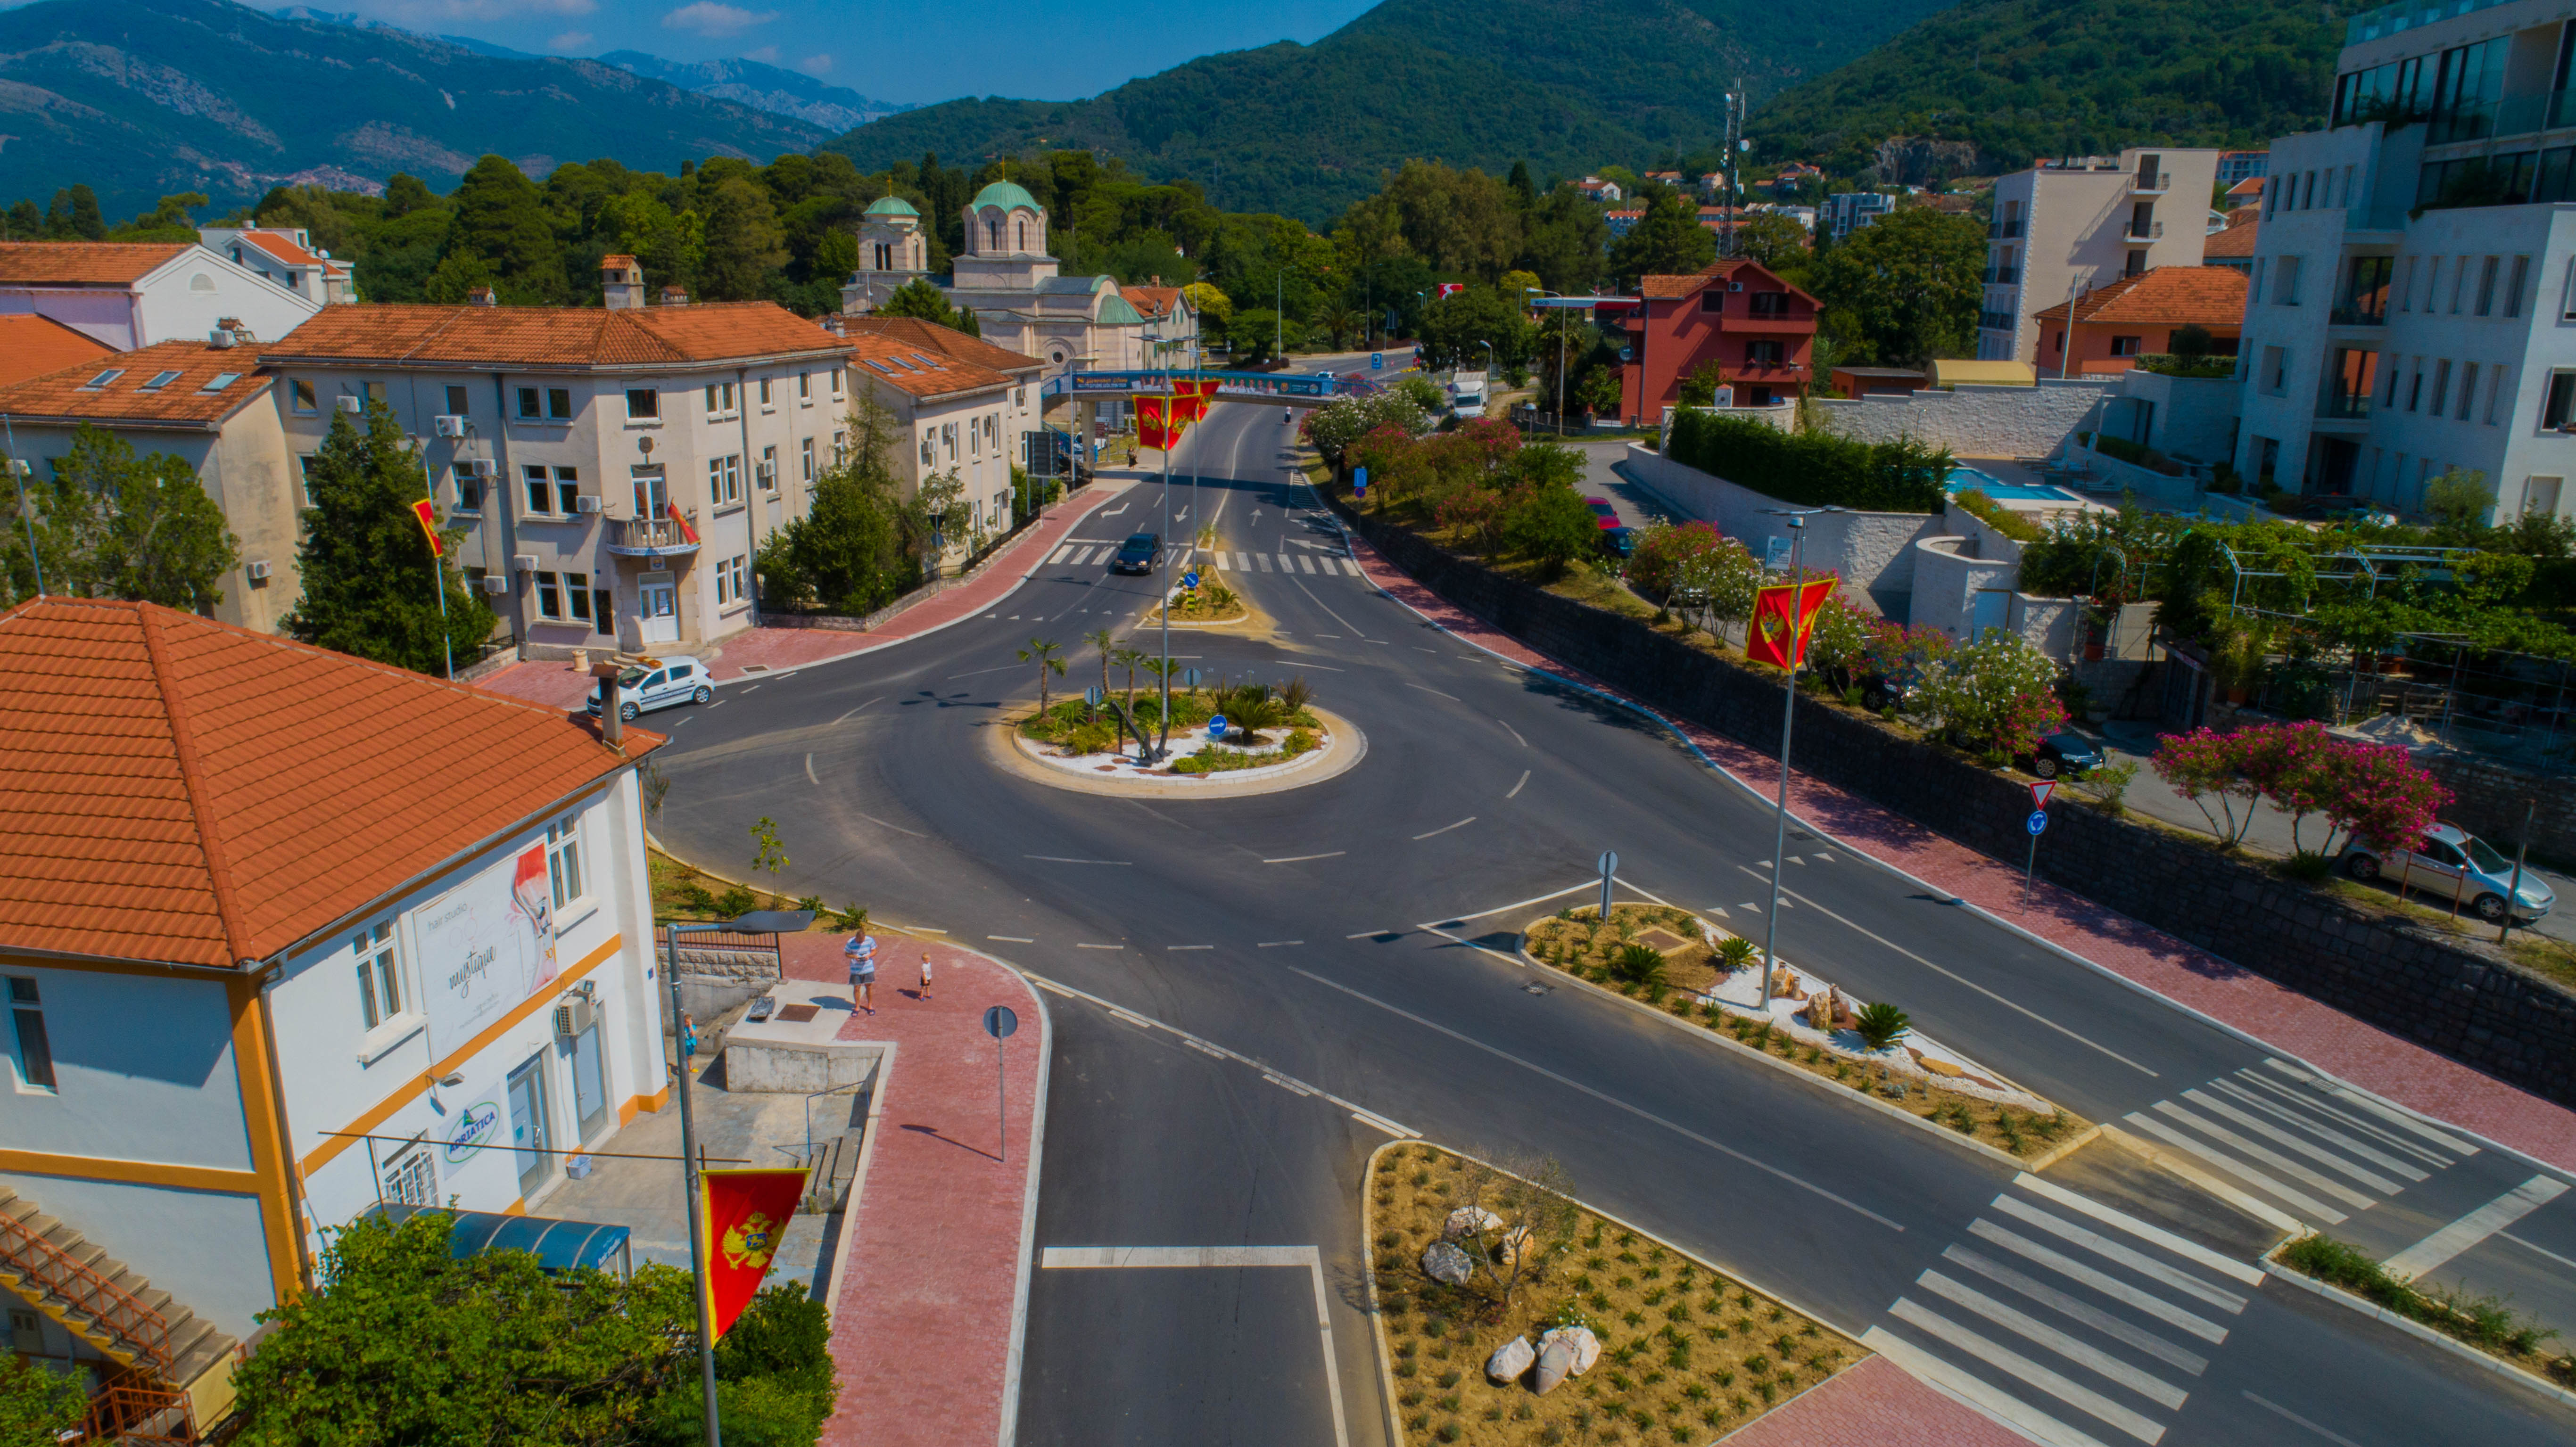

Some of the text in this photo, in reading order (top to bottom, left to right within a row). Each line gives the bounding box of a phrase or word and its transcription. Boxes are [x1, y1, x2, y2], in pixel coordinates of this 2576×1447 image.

[428, 902, 468, 932] hair studio
[449, 946, 496, 999] mystique
[449, 1111, 495, 1154] ADRIATICA
